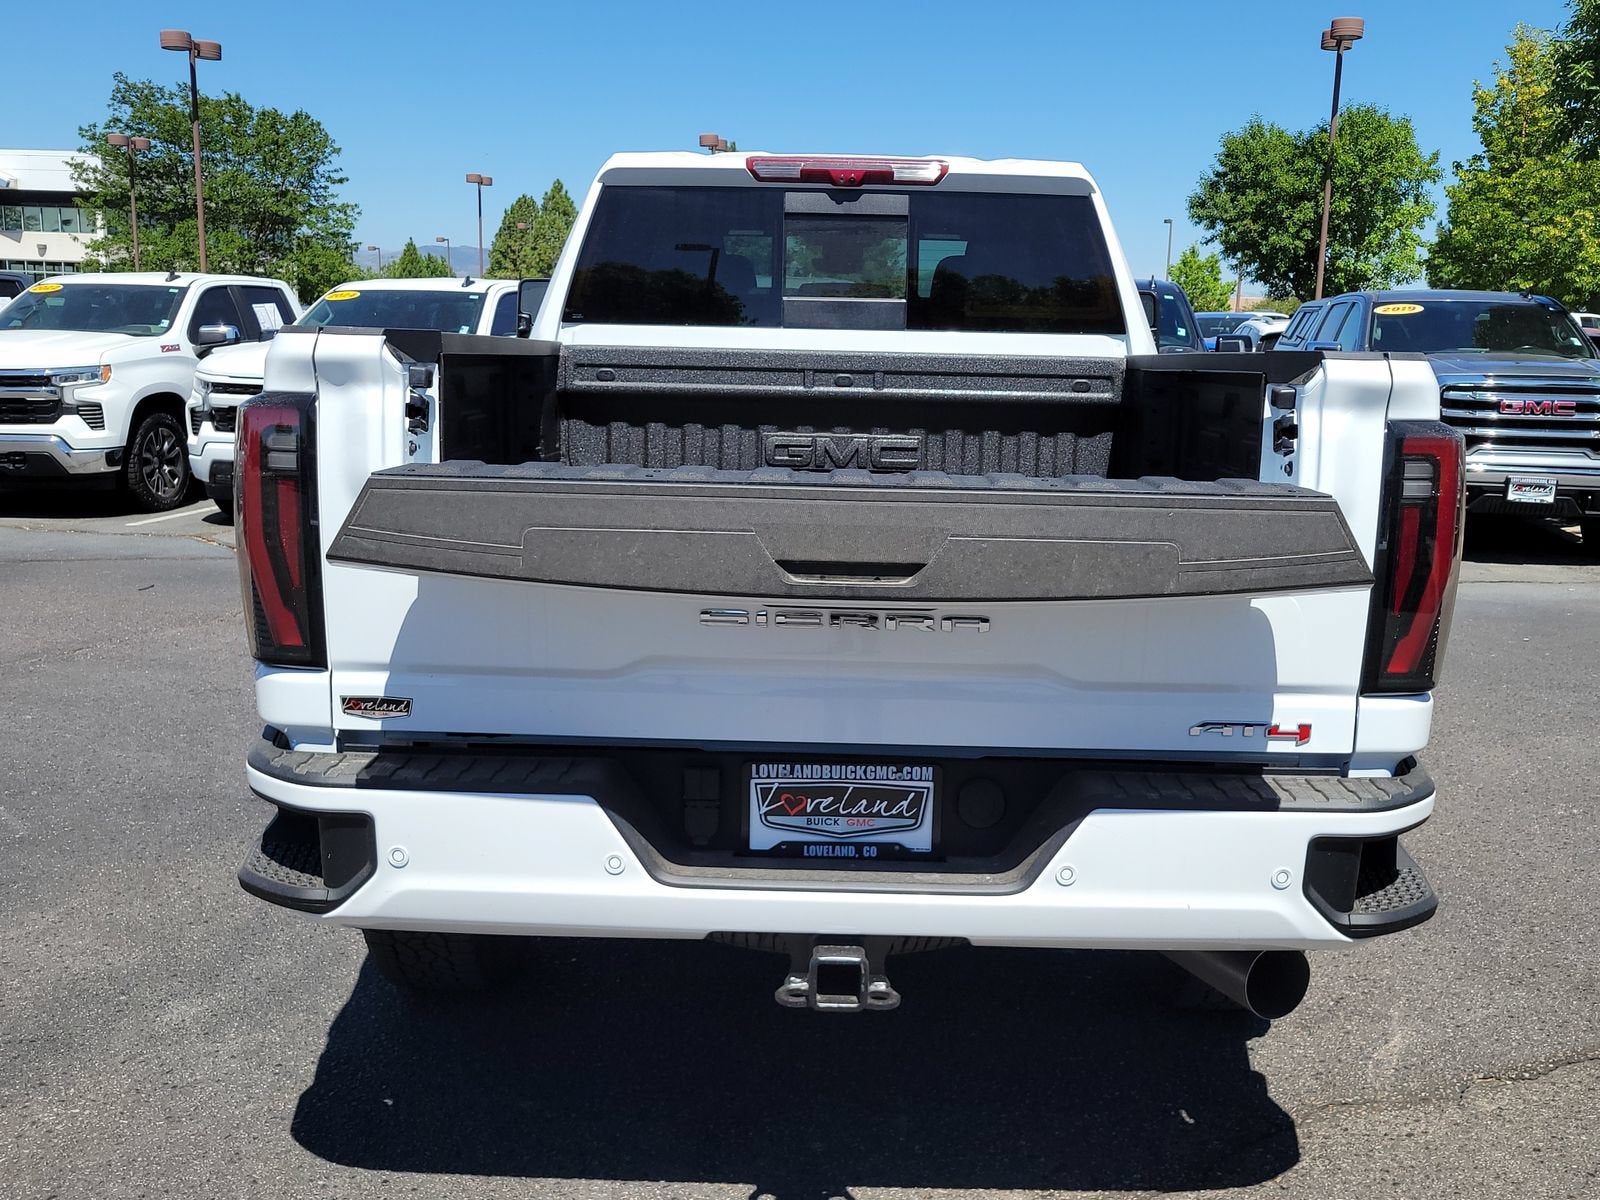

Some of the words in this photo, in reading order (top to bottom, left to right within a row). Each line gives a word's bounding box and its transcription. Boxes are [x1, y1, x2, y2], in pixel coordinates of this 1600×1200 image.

[1500, 400, 1577, 416] GMC
[764, 436, 920, 470] GMC
[700, 608, 991, 633] SIERRA
[343, 697, 408, 712] Loveland
[1189, 721, 1312, 747] AT4
[751, 764, 934, 781] LOVELANDBUICKGMC.COM
[760, 783, 917, 817] Loveland
[806, 817, 841, 827] BUICK
[846, 818, 876, 828] GMC
[803, 845, 859, 858] LOVELAND,
[863, 845, 878, 858] CO
